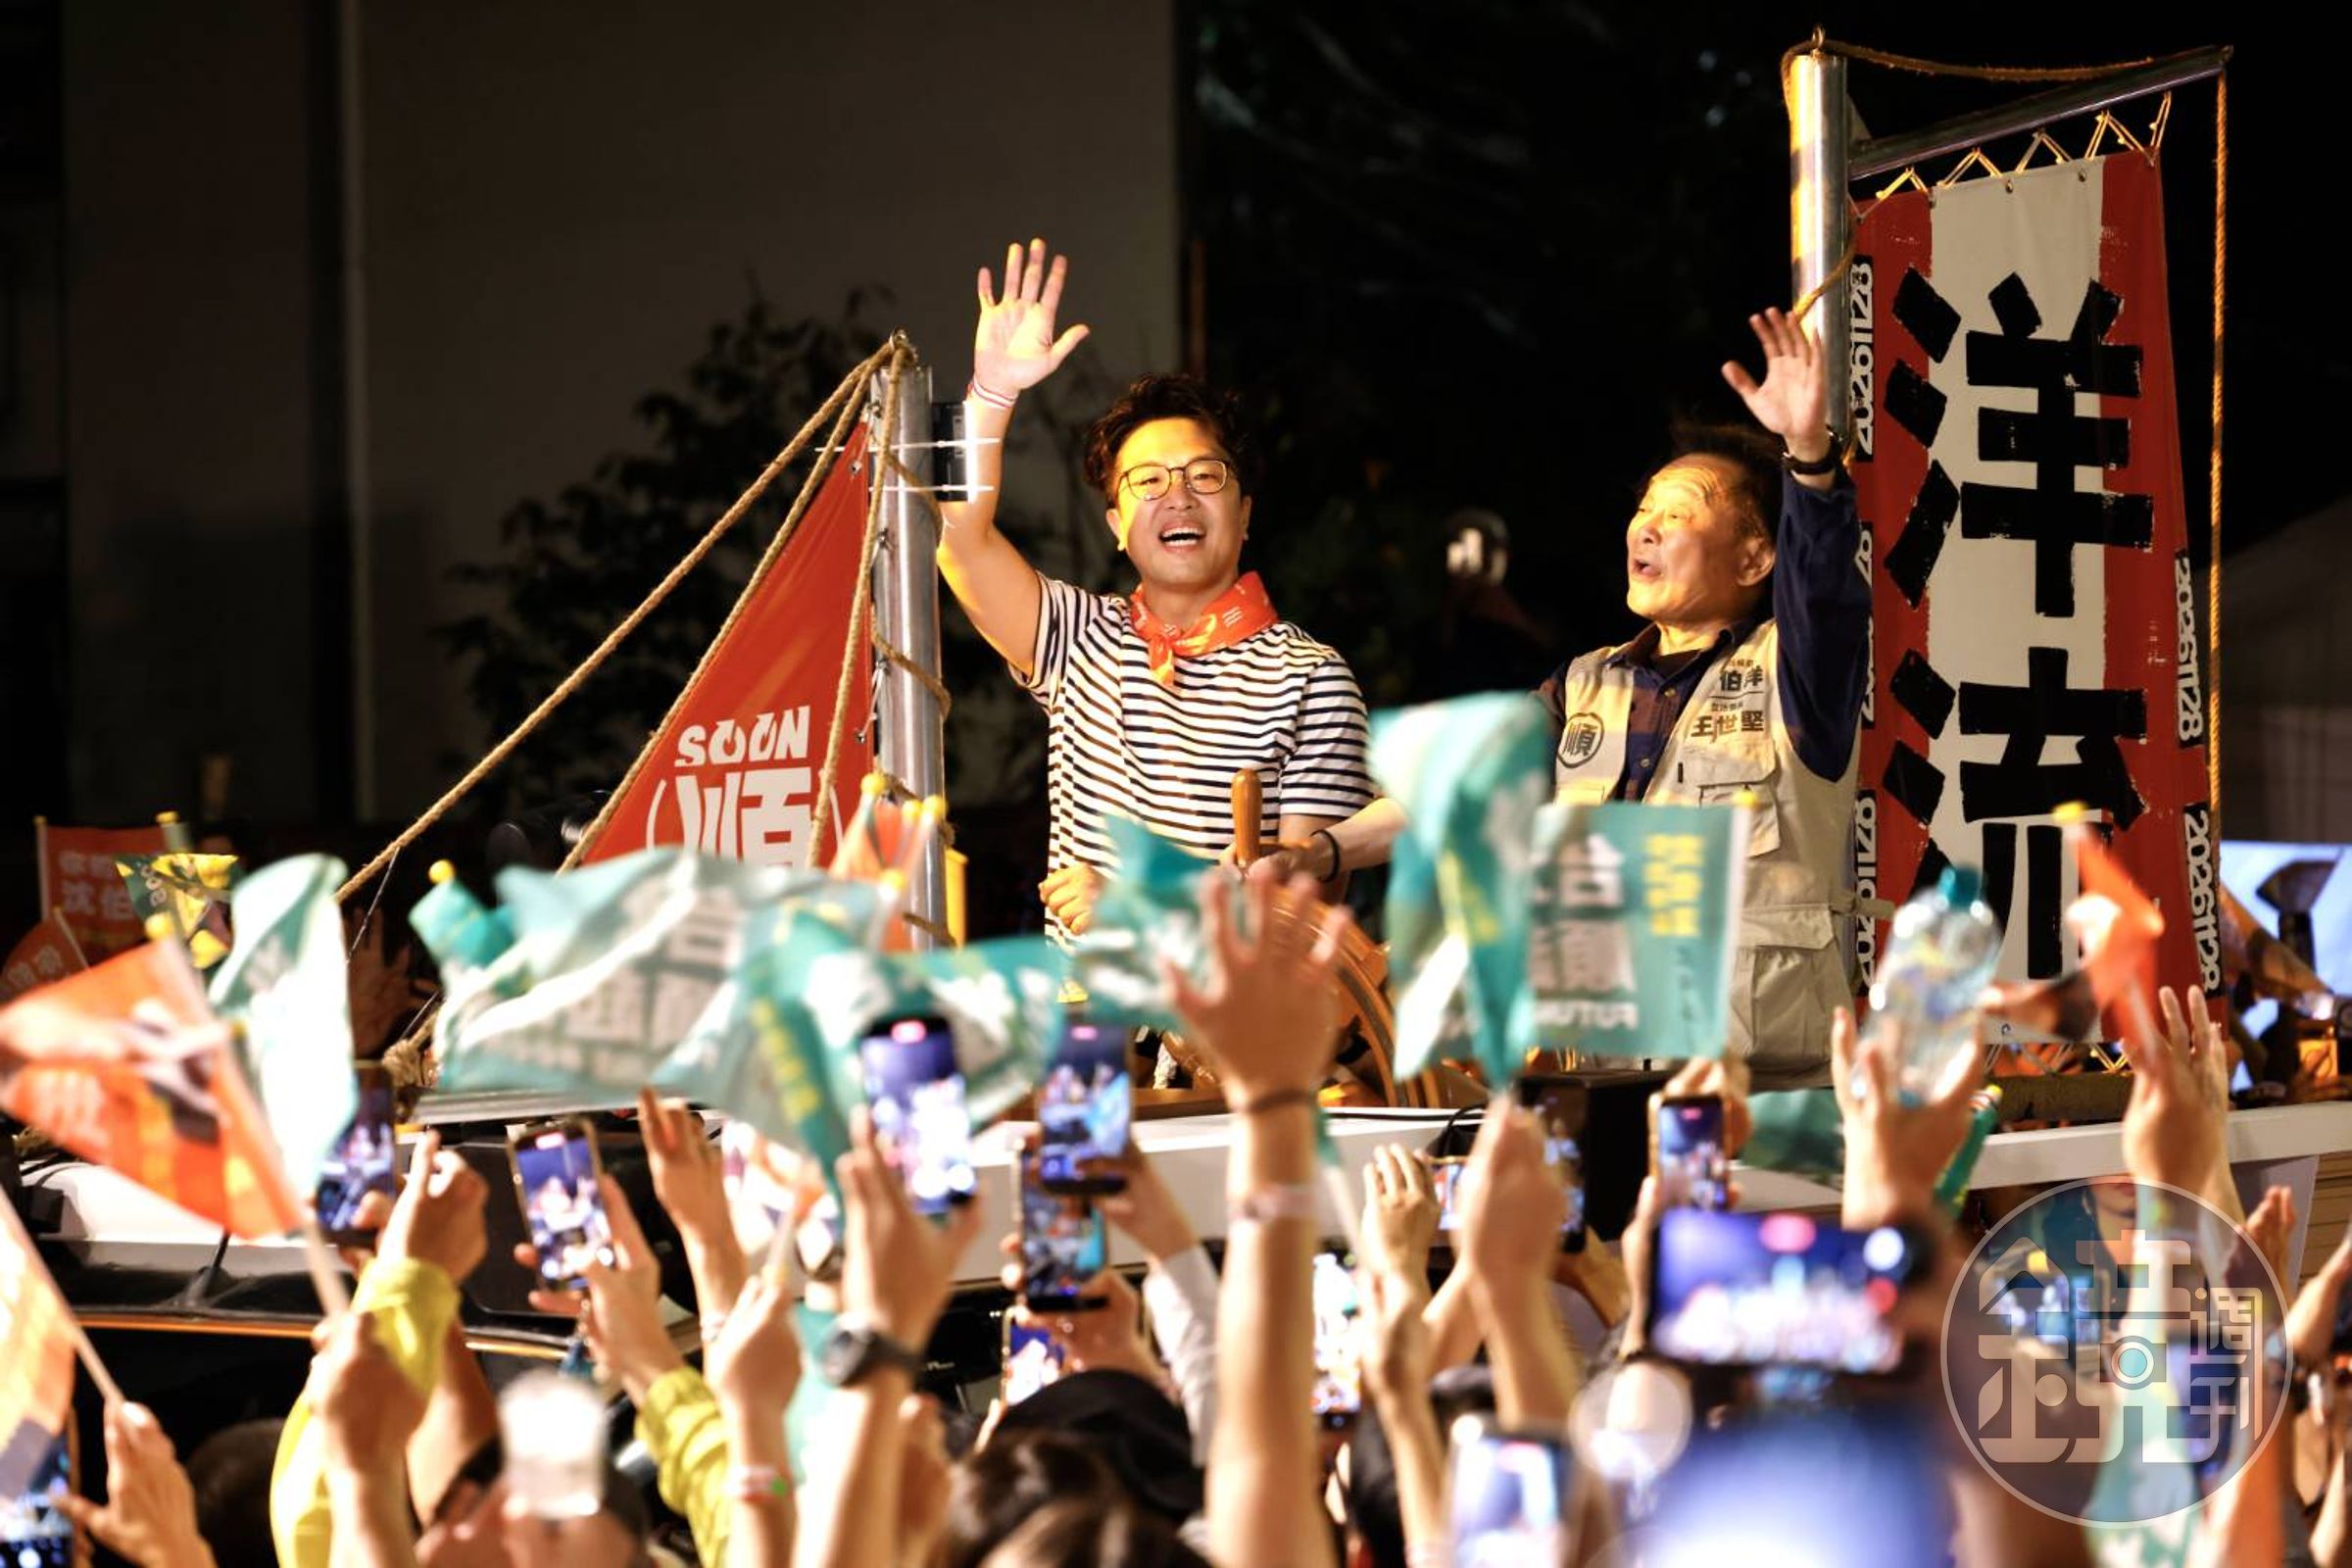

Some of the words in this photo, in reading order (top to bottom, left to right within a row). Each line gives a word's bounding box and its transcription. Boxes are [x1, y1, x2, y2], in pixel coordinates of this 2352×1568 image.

[1881, 266, 2156, 982] 洋流
[2175, 557, 2203, 741] 20261128
[674, 706, 810, 767] SOON
[1563, 721, 1598, 757] 順
[1690, 710, 1764, 737] 王世堅
[2184, 809, 2221, 994] 20261128
